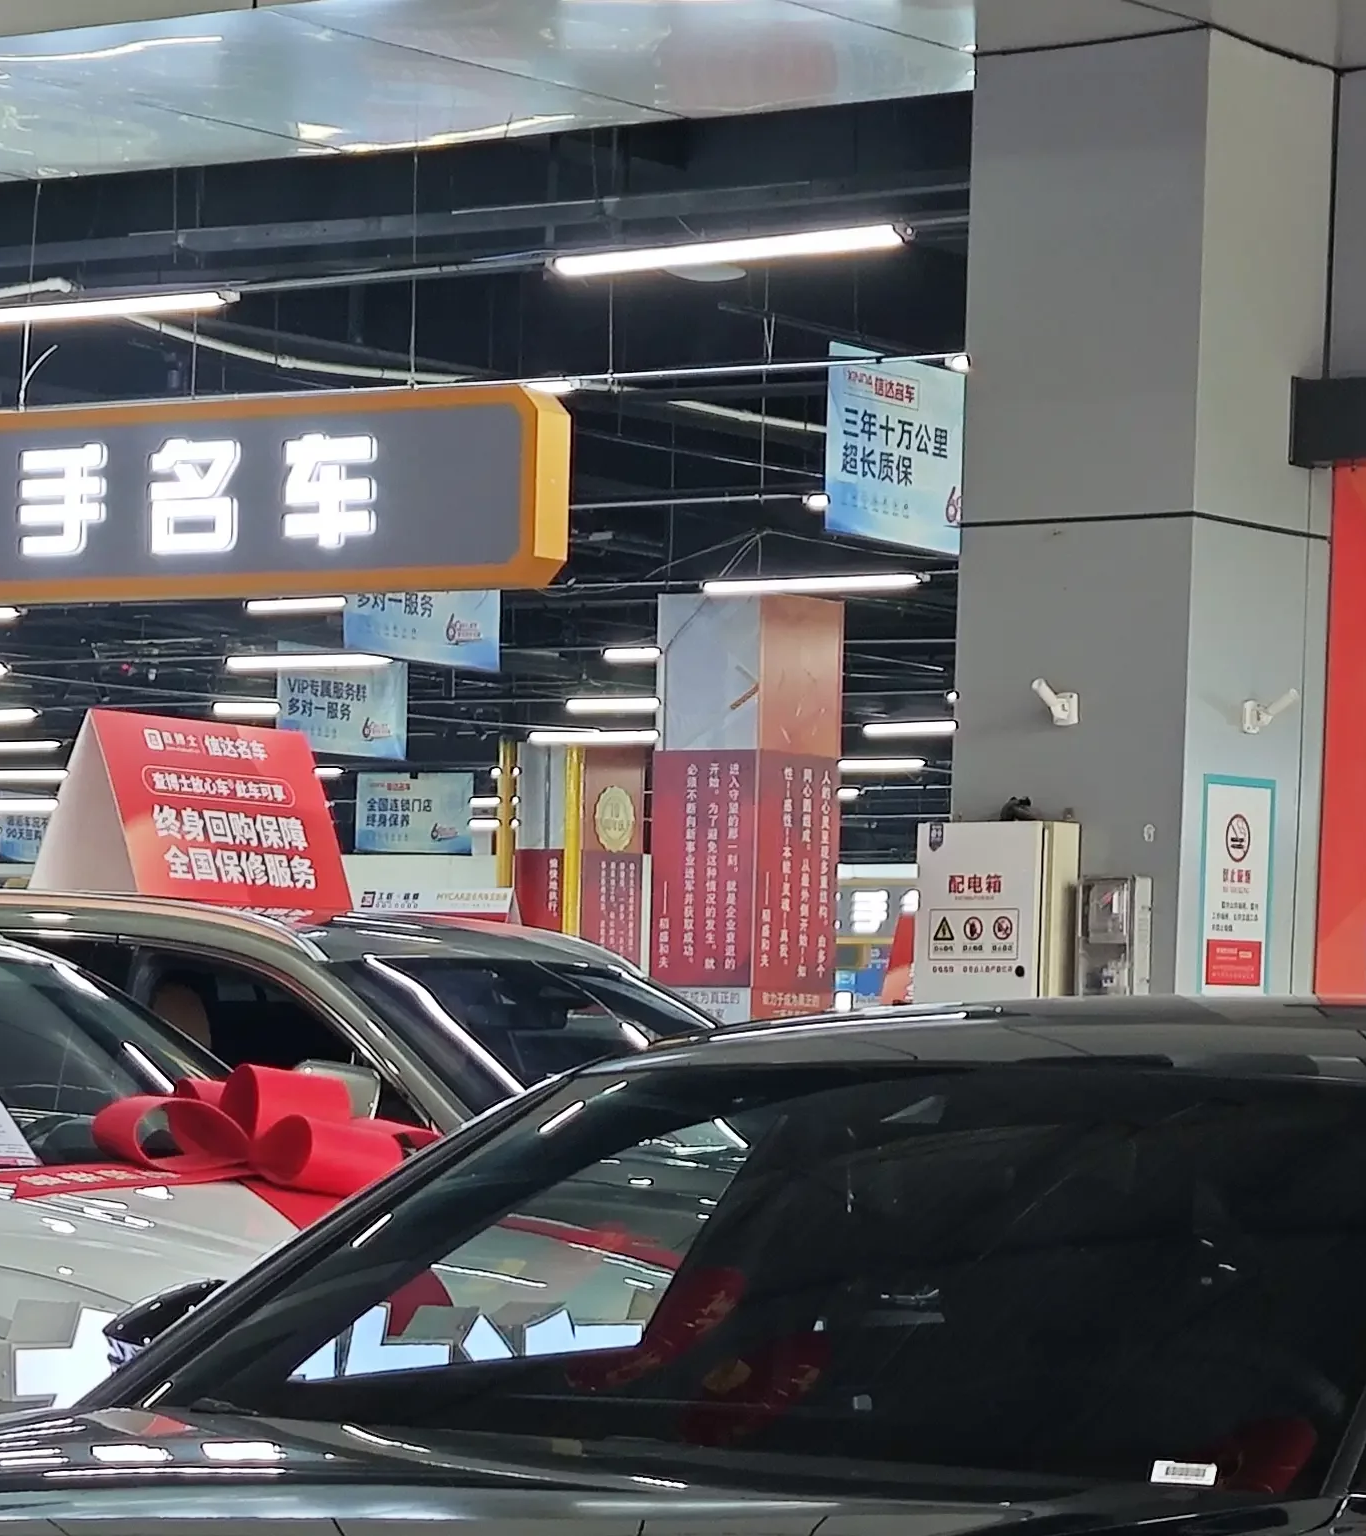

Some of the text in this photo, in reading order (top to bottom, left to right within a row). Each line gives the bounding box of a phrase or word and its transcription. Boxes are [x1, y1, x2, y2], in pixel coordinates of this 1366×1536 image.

[874, 376, 915, 403] 信达名车
[843, 407, 948, 459] 三年十万公里
[841, 442, 913, 487] 超长质保
[287, 678, 367, 702] VIP专属服务群
[288, 699, 352, 721] 多对一服务
[203, 734, 269, 760] 信达名车
[367, 798, 432, 812] 全国连锁门店
[152, 804, 310, 852] 终身回购保障
[366, 814, 410, 827] 终身保养
[164, 845, 319, 890] 全国保修服务
[948, 874, 1002, 894] 配电箱
